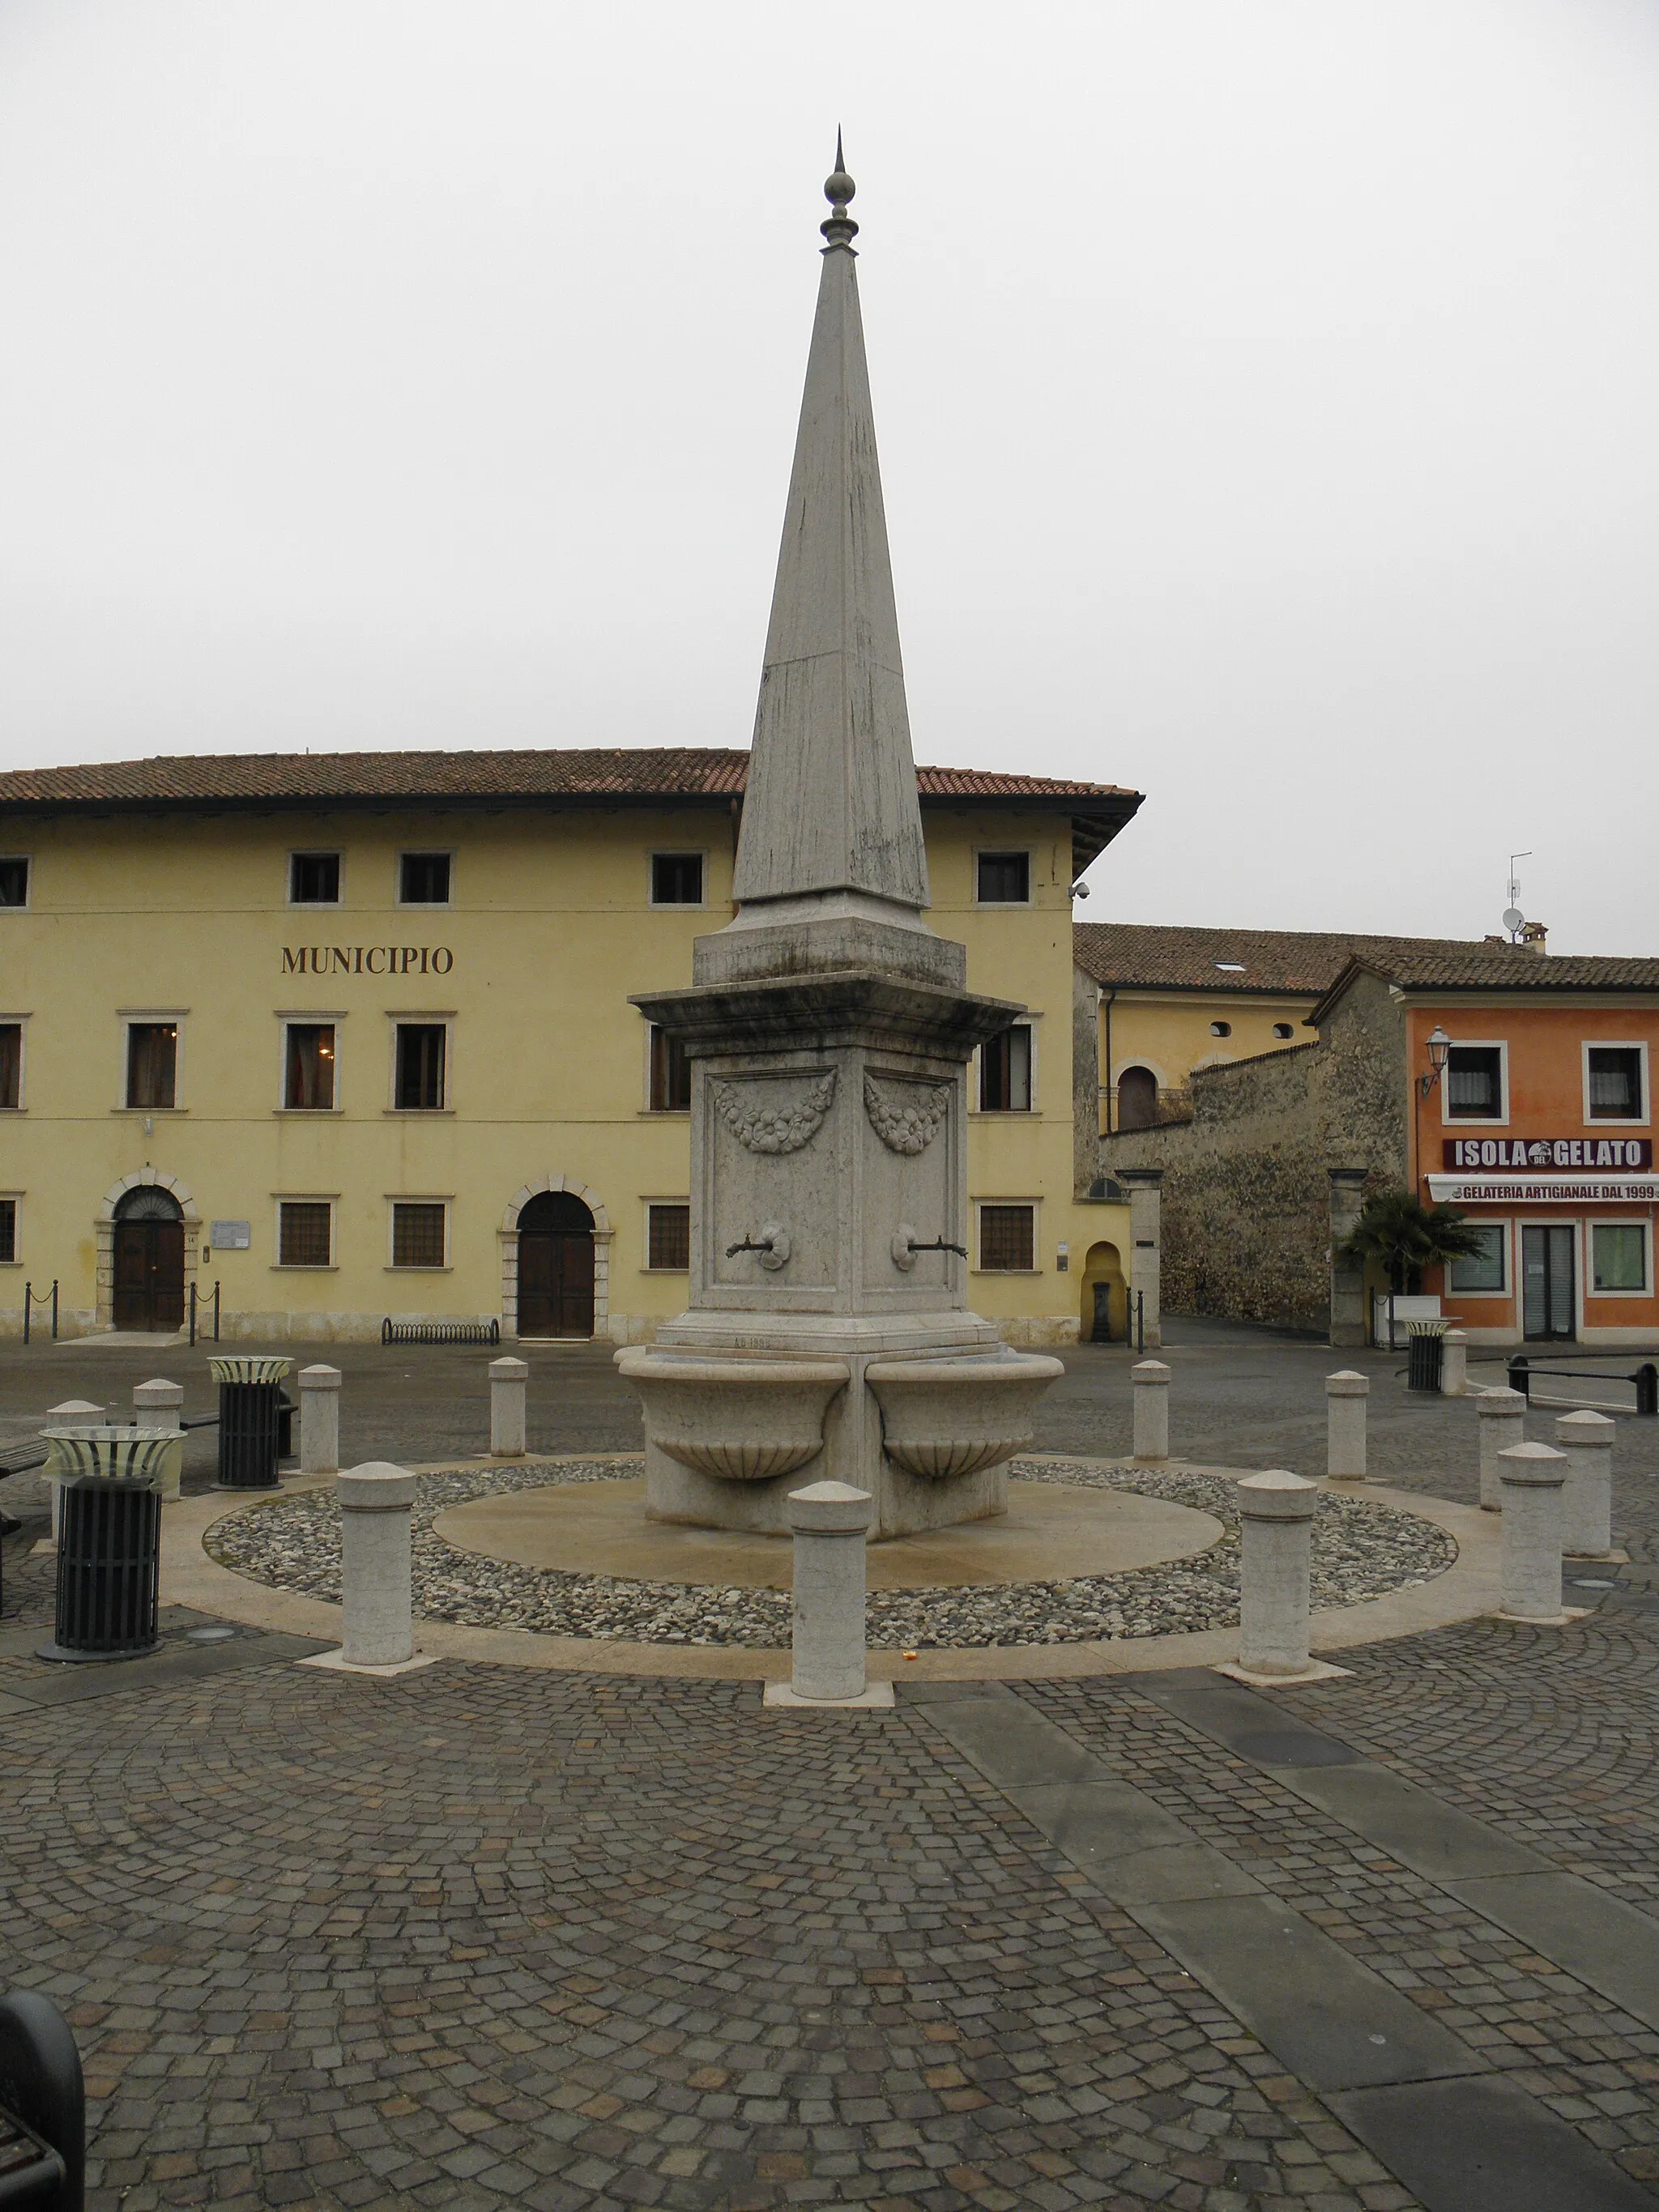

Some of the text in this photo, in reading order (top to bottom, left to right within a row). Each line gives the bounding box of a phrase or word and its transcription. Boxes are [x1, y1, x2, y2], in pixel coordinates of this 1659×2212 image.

[281, 947, 454, 974] MUNICIPIO
[1455, 1140, 1640, 1166] ISOLA DEL GELATO
[1463, 1186, 1654, 1199] GELATERIA ARTIGIANALE DAL 1999
